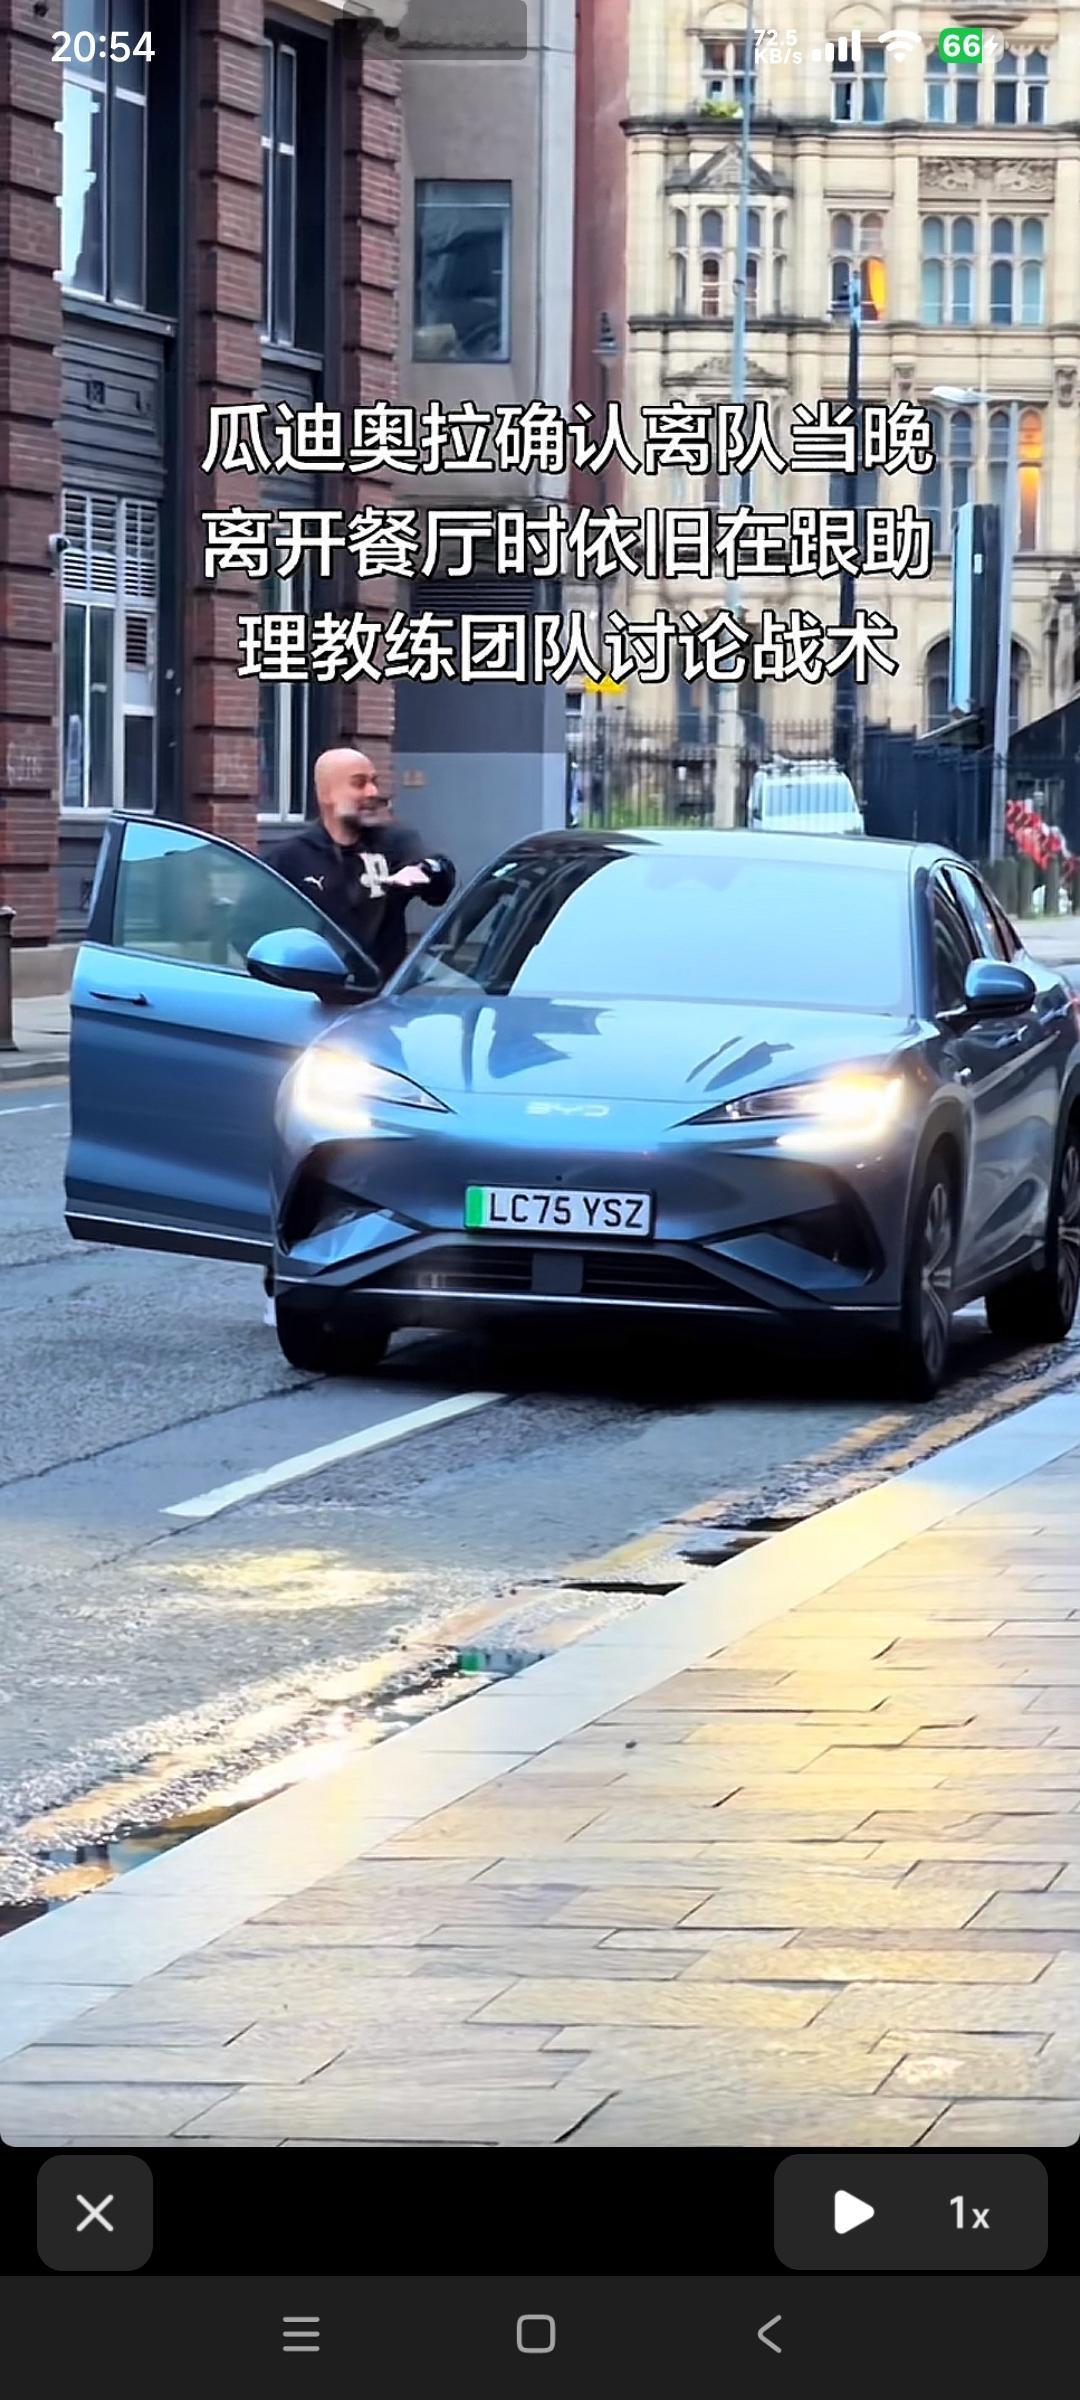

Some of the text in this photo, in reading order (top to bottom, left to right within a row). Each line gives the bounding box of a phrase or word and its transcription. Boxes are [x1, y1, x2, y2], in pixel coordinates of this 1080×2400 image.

[525, 1100, 611, 1118] BYD
[489, 1192, 644, 1229] LC75 YSZ
